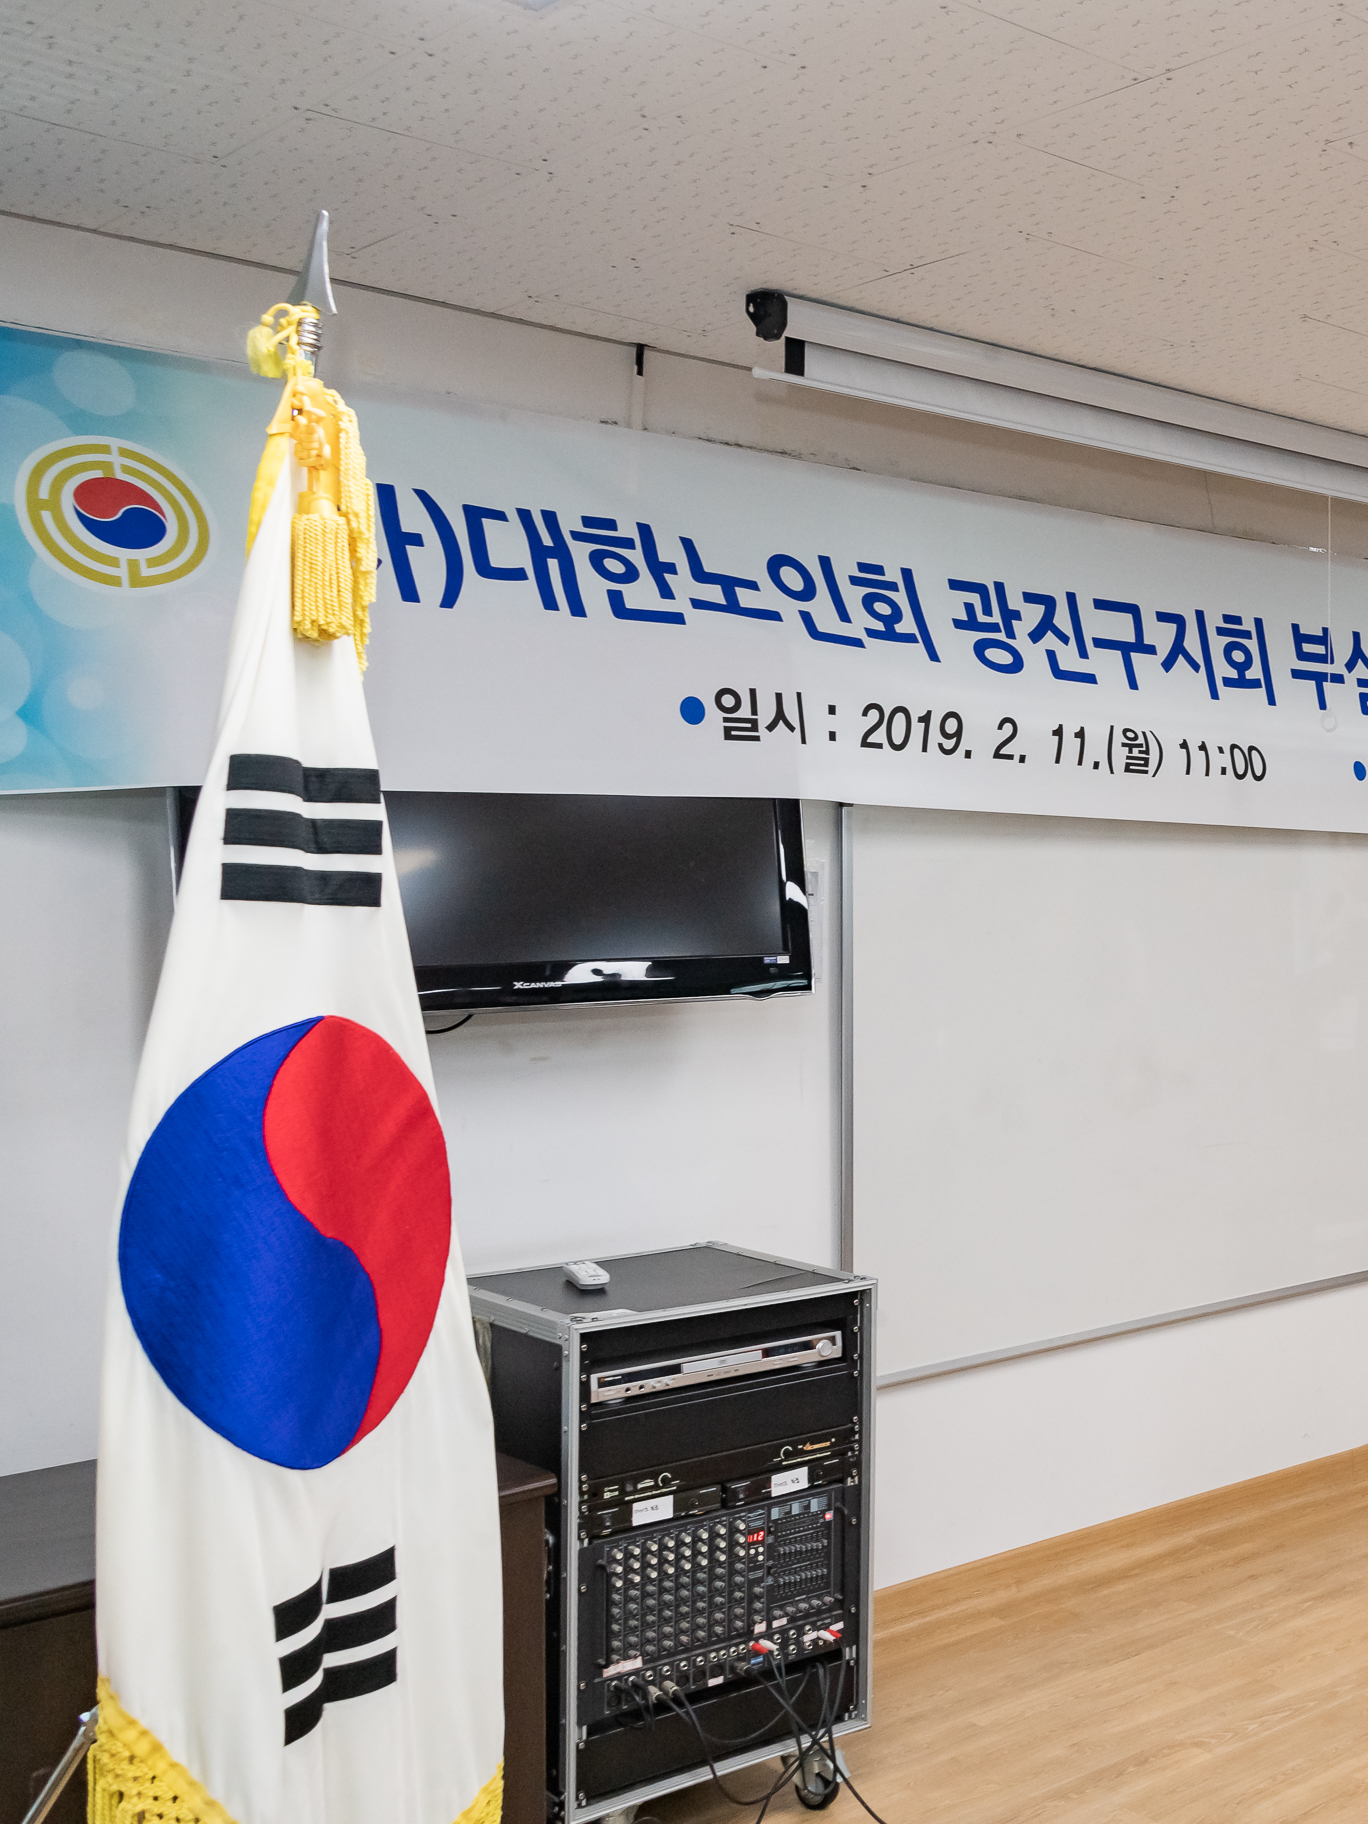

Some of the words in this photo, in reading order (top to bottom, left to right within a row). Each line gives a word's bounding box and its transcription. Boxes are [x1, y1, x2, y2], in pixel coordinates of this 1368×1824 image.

[949, 578, 1276, 706] 광진구지회
[715, 687, 807, 745] 일시
[860, 702, 972, 760] 2019.
[992, 716, 1027, 764] 2.
[1052, 723, 1164, 780] 11.(월)
[1179, 738, 1267, 782] 11:00
